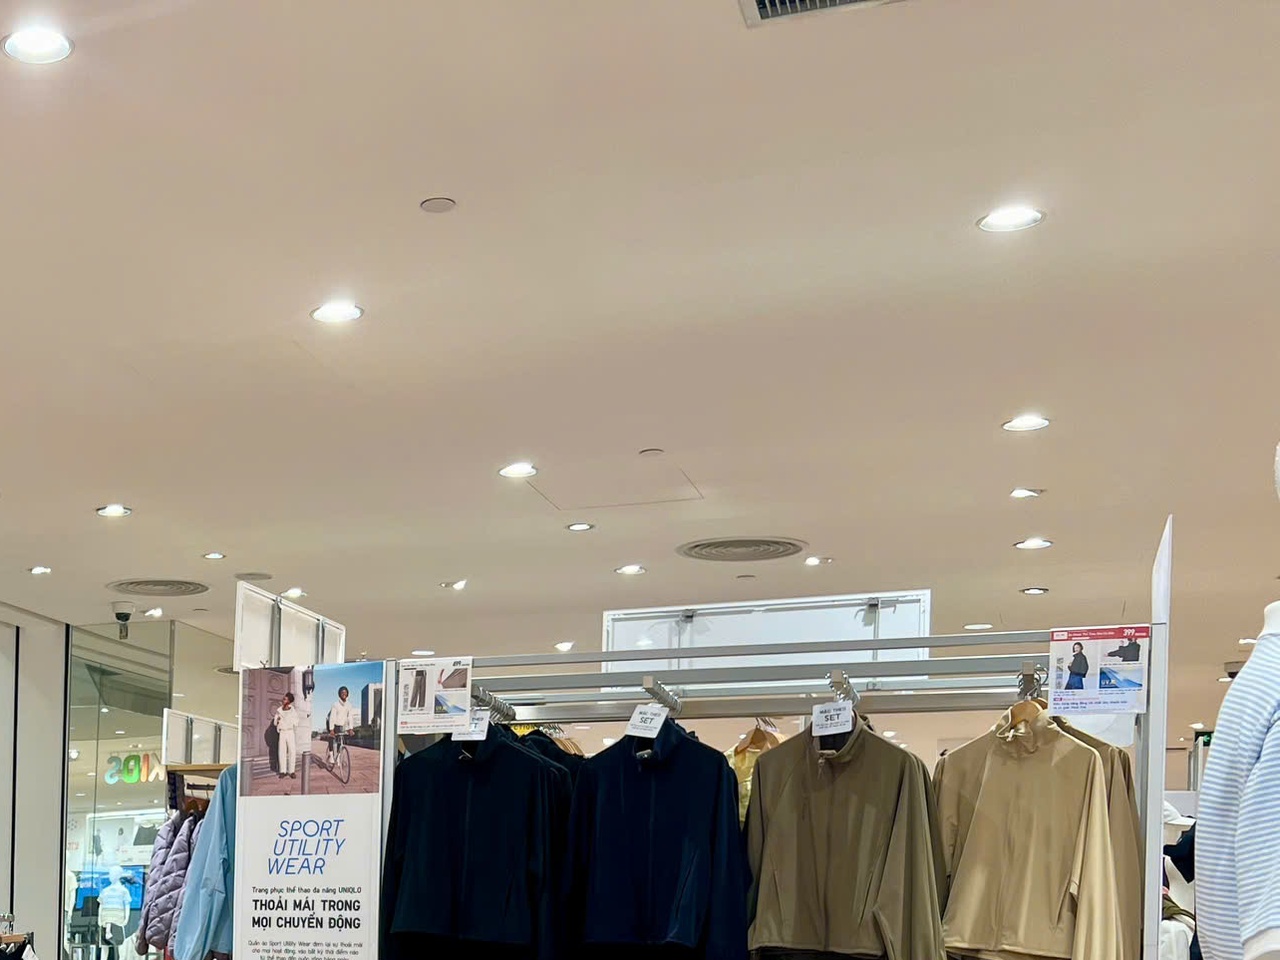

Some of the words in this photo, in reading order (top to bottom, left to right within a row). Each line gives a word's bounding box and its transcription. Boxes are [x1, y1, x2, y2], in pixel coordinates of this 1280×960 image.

[639, 717, 654, 725] SET
[824, 713, 841, 722] SET
[278, 819, 344, 838] SPORT
[273, 838, 346, 856] UTILITY
[268, 857, 326, 875] WEAR
[252, 895, 288, 911] THOẢI
[293, 896, 315, 911] MÁI
[321, 899, 361, 911] TRONG
[252, 916, 271, 931] MỌI
[276, 912, 323, 929] CHUYỂN
[328, 914, 361, 932] ĐỘNG
